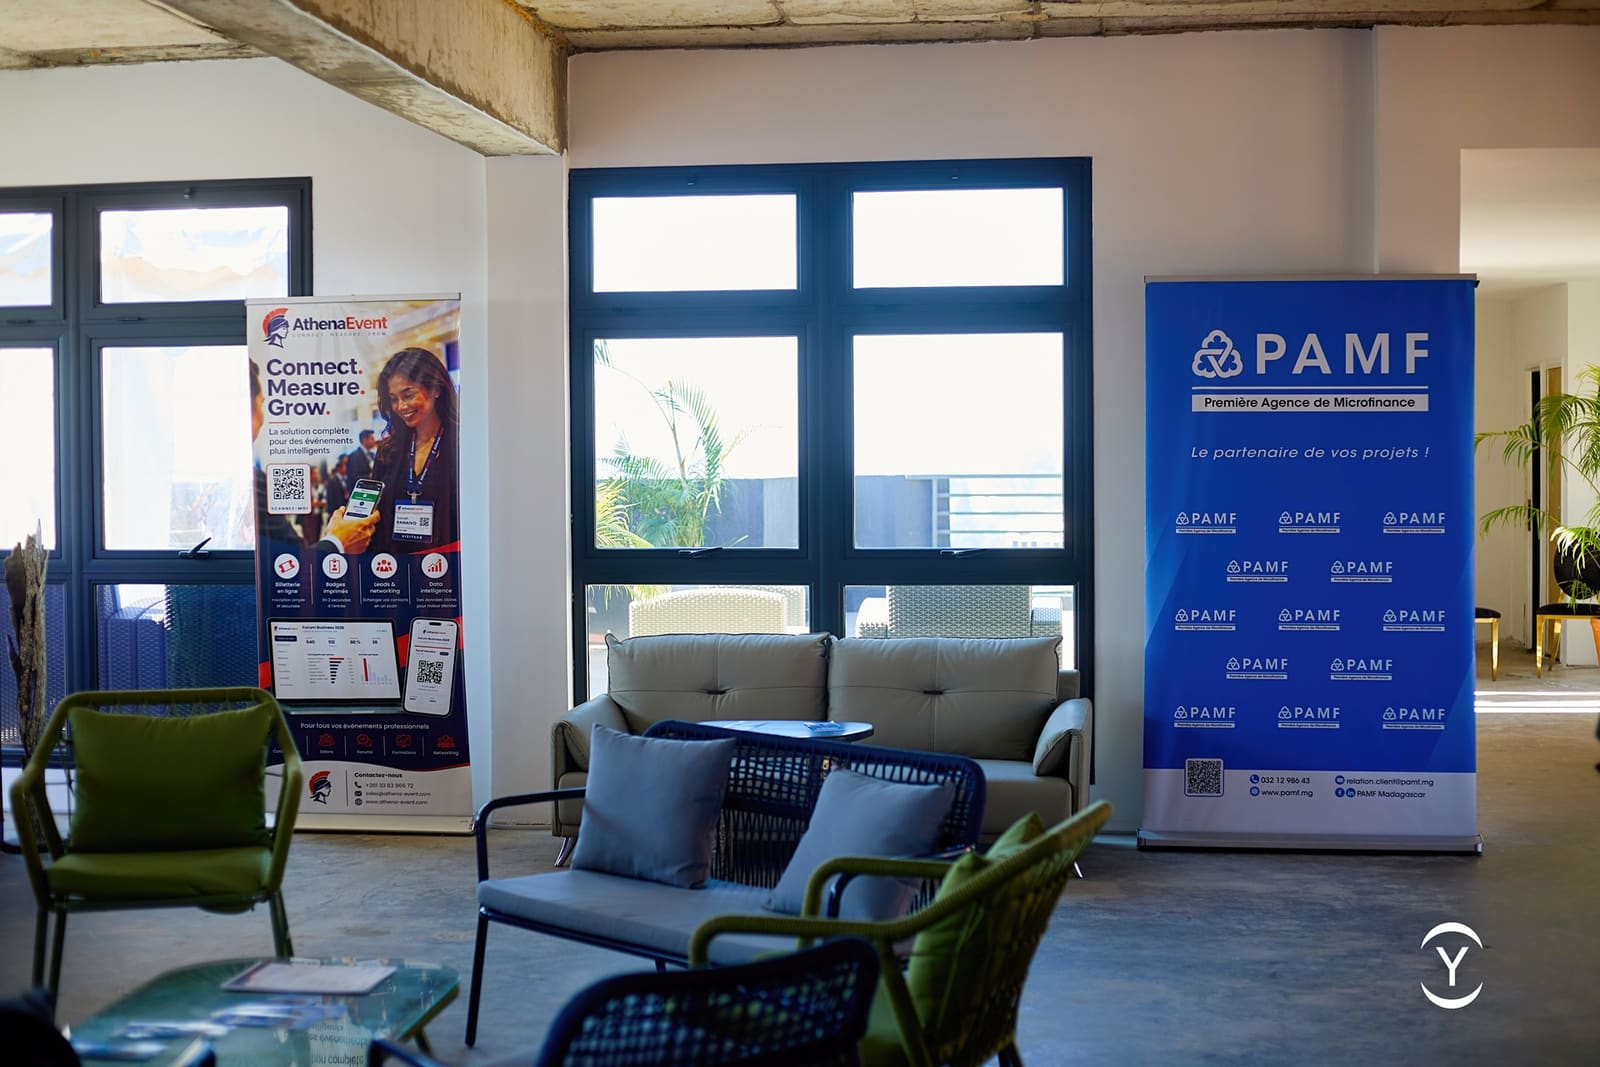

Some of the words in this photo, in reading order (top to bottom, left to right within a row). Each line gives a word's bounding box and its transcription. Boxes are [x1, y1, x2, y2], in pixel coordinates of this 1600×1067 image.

[292, 316, 388, 331] AthenaEvent
[1256, 333, 1429, 374] PAMF
[266, 358, 363, 376] Connect.
[267, 379, 365, 396] Measure.
[267, 399, 330, 416] Grow.
[1204, 397, 1258, 408] Première
[1261, 397, 1310, 410] Agence
[1313, 397, 1330, 408] de
[1334, 397, 1415, 408] Microfinance
[280, 428, 310, 436] solution
[312, 427, 350, 436] complète
[304, 437, 354, 445] événements
[270, 448, 286, 456] plus
[288, 447, 330, 456] intelligents
[1191, 447, 1208, 458] Le
[1213, 447, 1299, 460] partenaire
[1304, 447, 1325, 458] de
[1331, 449, 1357, 458] vos
[1362, 447, 1418, 460] projets
[1424, 447, 1430, 458] !
[1192, 513, 1236, 524] PAMF
[1295, 512, 1340, 524] PAMF
[1400, 512, 1446, 524] PAMF
[1243, 561, 1288, 573] PAMF
[1347, 561, 1393, 573] PAMF
[1191, 610, 1236, 622] PAMF
[1295, 610, 1340, 621] PAMF
[1400, 610, 1445, 622] PAMF
[1242, 658, 1288, 670] PAMF
[1347, 659, 1393, 671] PAMF
[1190, 707, 1236, 719] PAMF
[1295, 707, 1340, 719] PAMF
[1399, 708, 1445, 720] PAMF
[1346, 778, 1434, 787] relation.client@pamf.mg
[1261, 789, 1314, 798] www.pamf.mg
[1378, 790, 1426, 799] Madagascar
